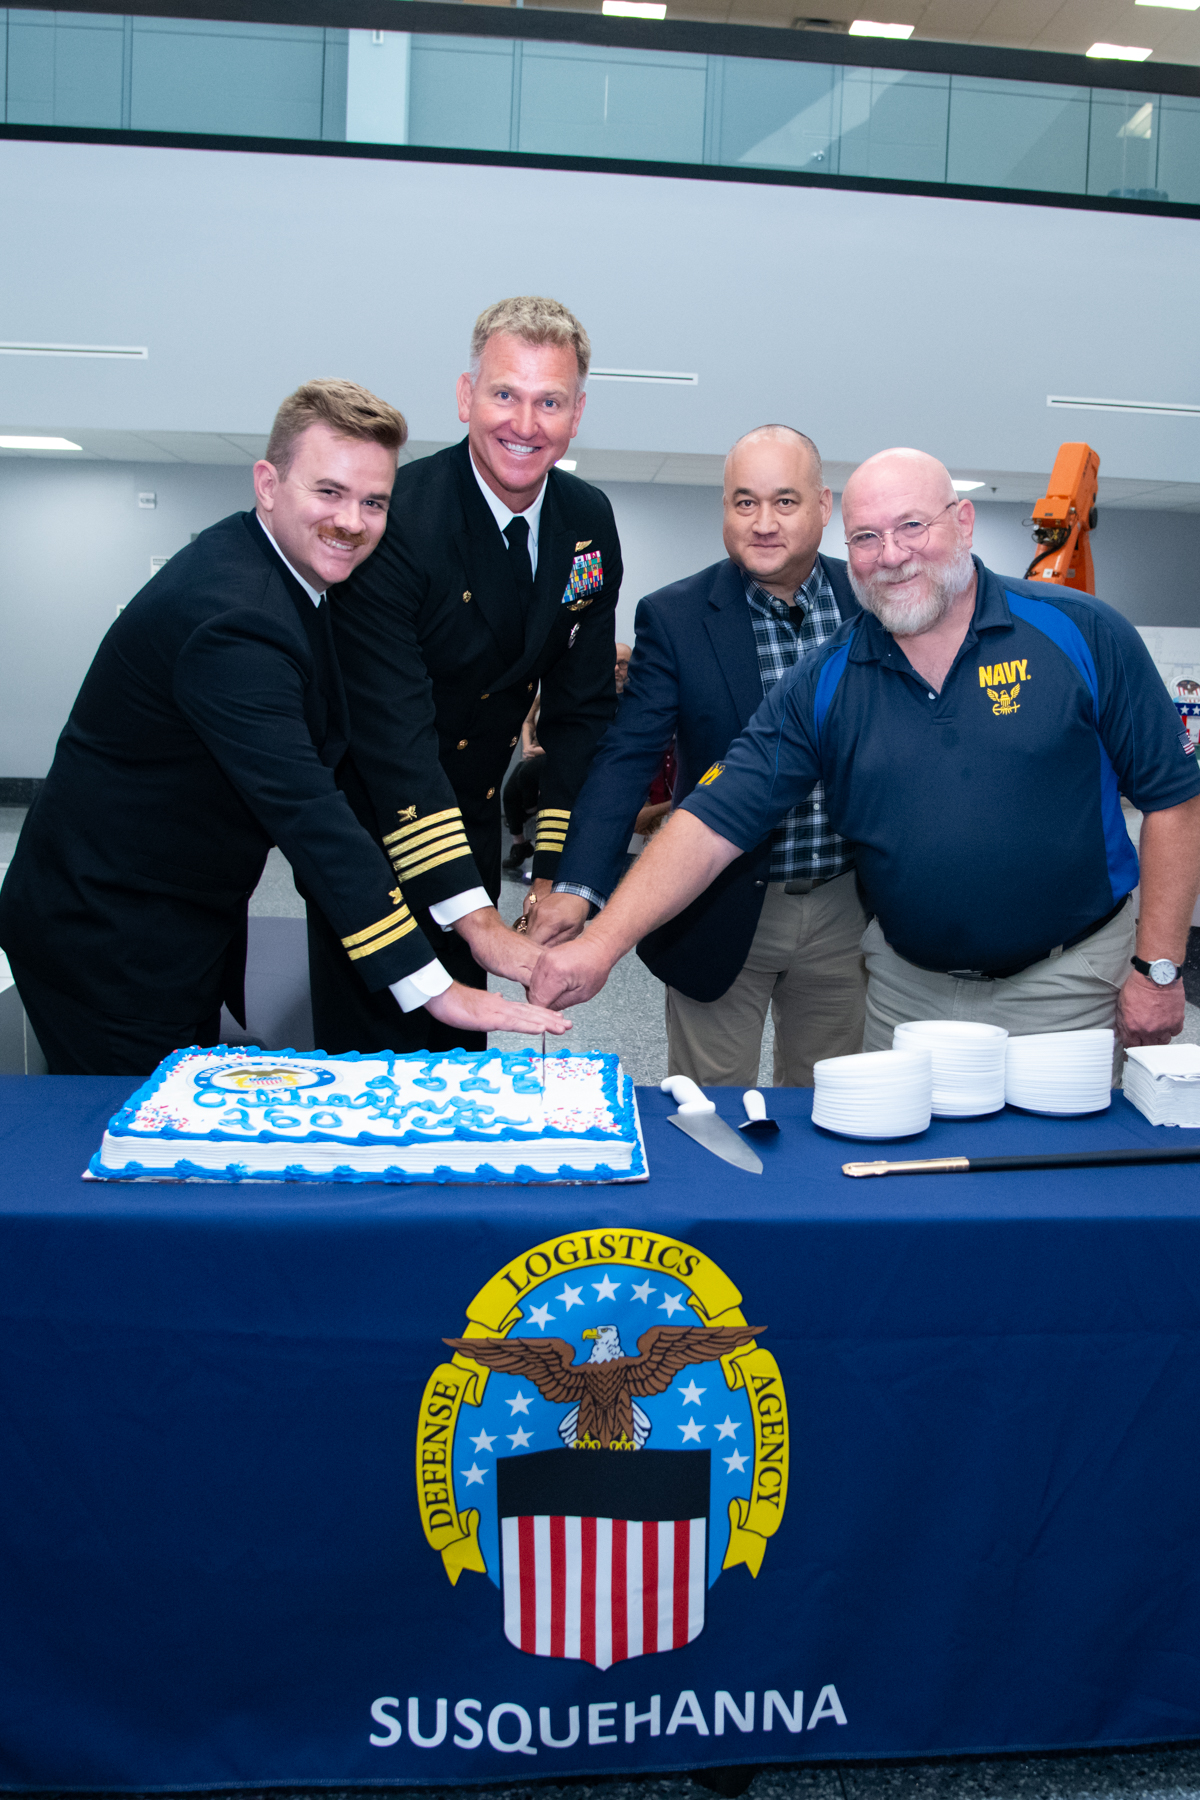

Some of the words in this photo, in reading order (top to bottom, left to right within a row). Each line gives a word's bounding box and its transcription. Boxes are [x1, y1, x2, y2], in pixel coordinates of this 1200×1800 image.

[423, 1380, 460, 1533] DEFENSE
[501, 1234, 701, 1295] LOGISTICS
[750, 1373, 784, 1510] AGENCY
[369, 1684, 848, 1755] SUSQUEHANNA
